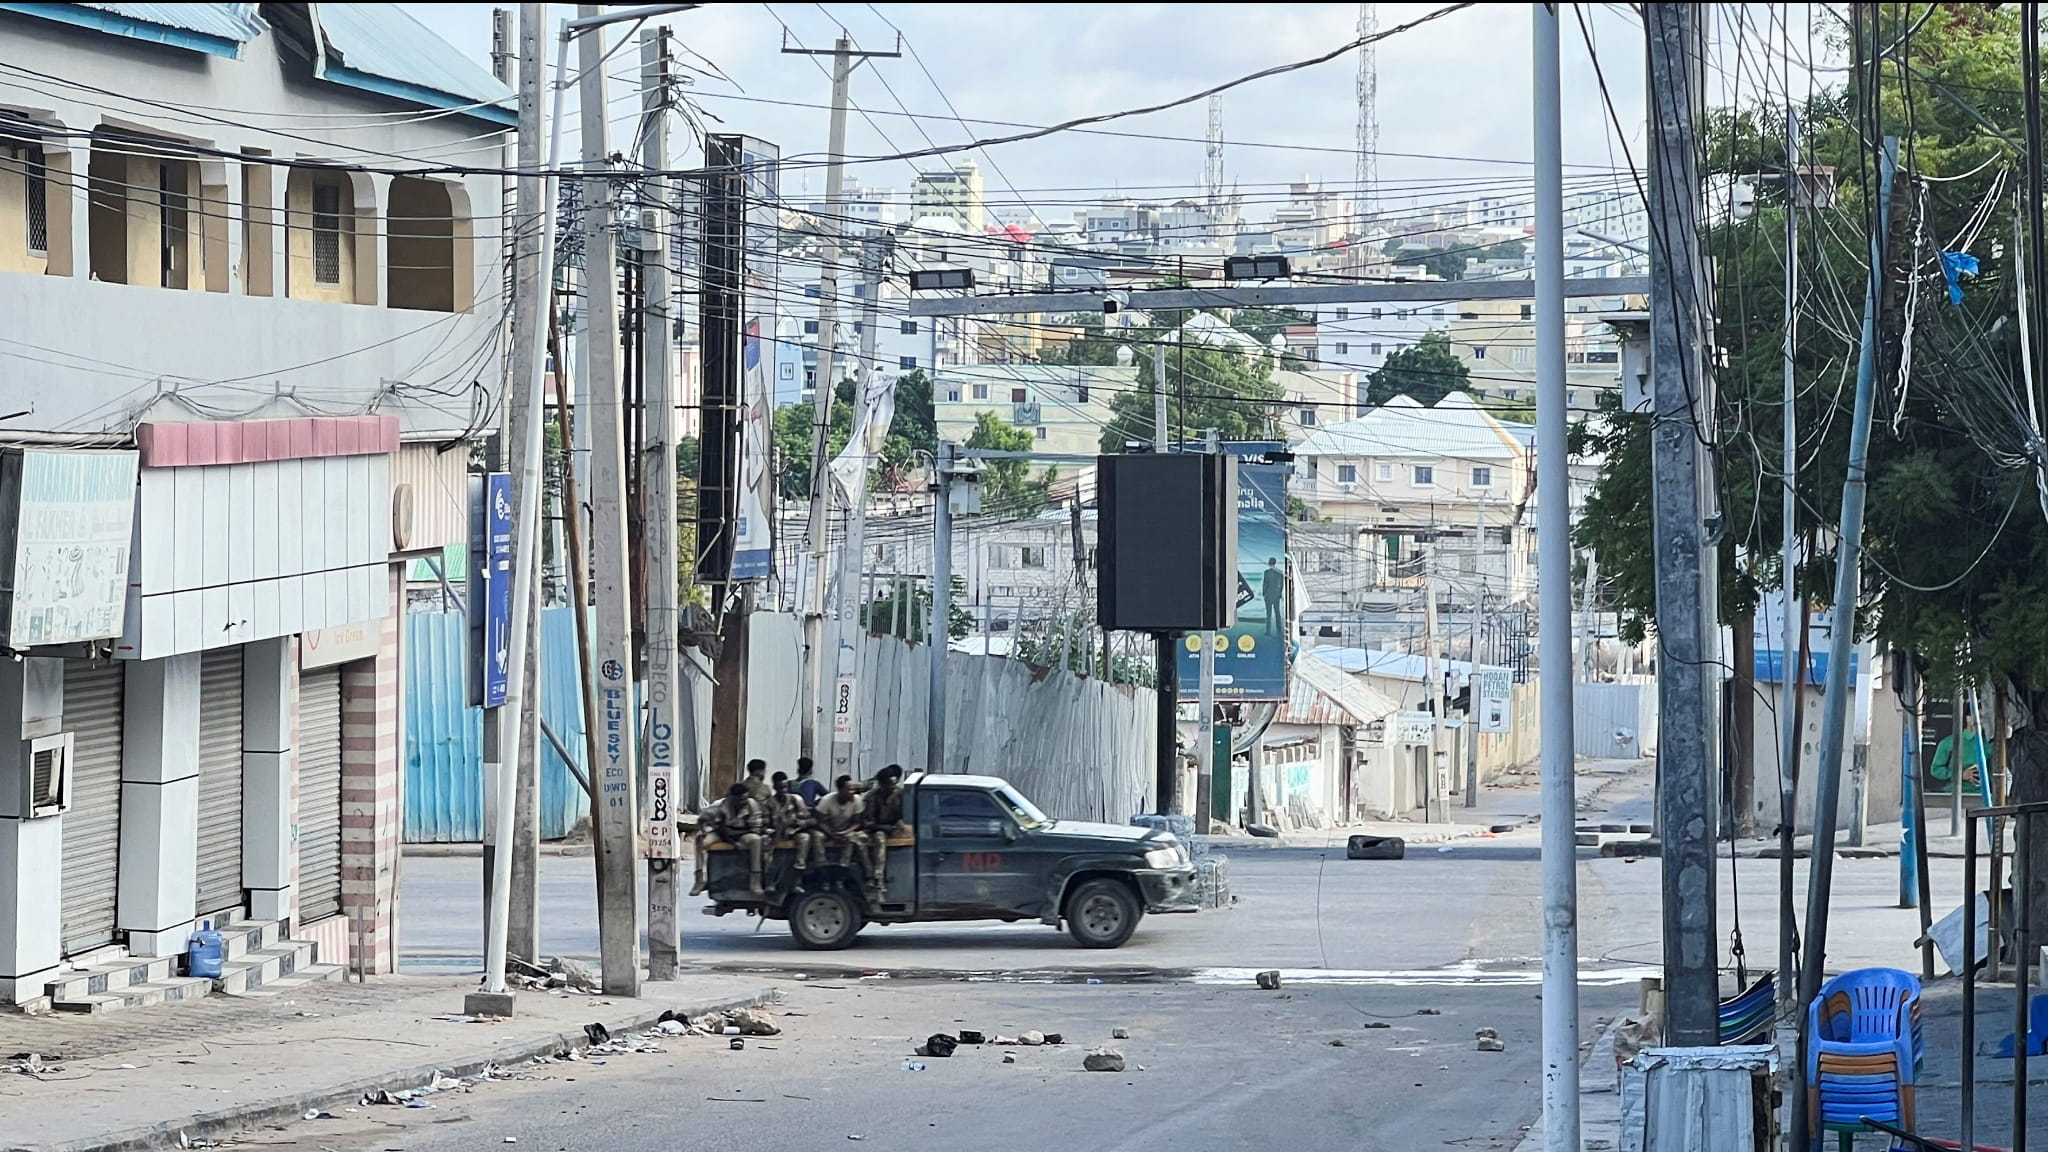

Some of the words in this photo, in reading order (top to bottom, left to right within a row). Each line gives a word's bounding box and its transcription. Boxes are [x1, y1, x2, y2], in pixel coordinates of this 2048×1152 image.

[1483, 671, 1509, 681] HODAN
[1483, 681, 1509, 690] PETROL
[1483, 690, 1510, 699] STATION
[606, 689, 621, 764] BLUESKY
[605, 767, 623, 777] ECO
[610, 797, 623, 808] 01
[650, 777, 667, 821] beco
